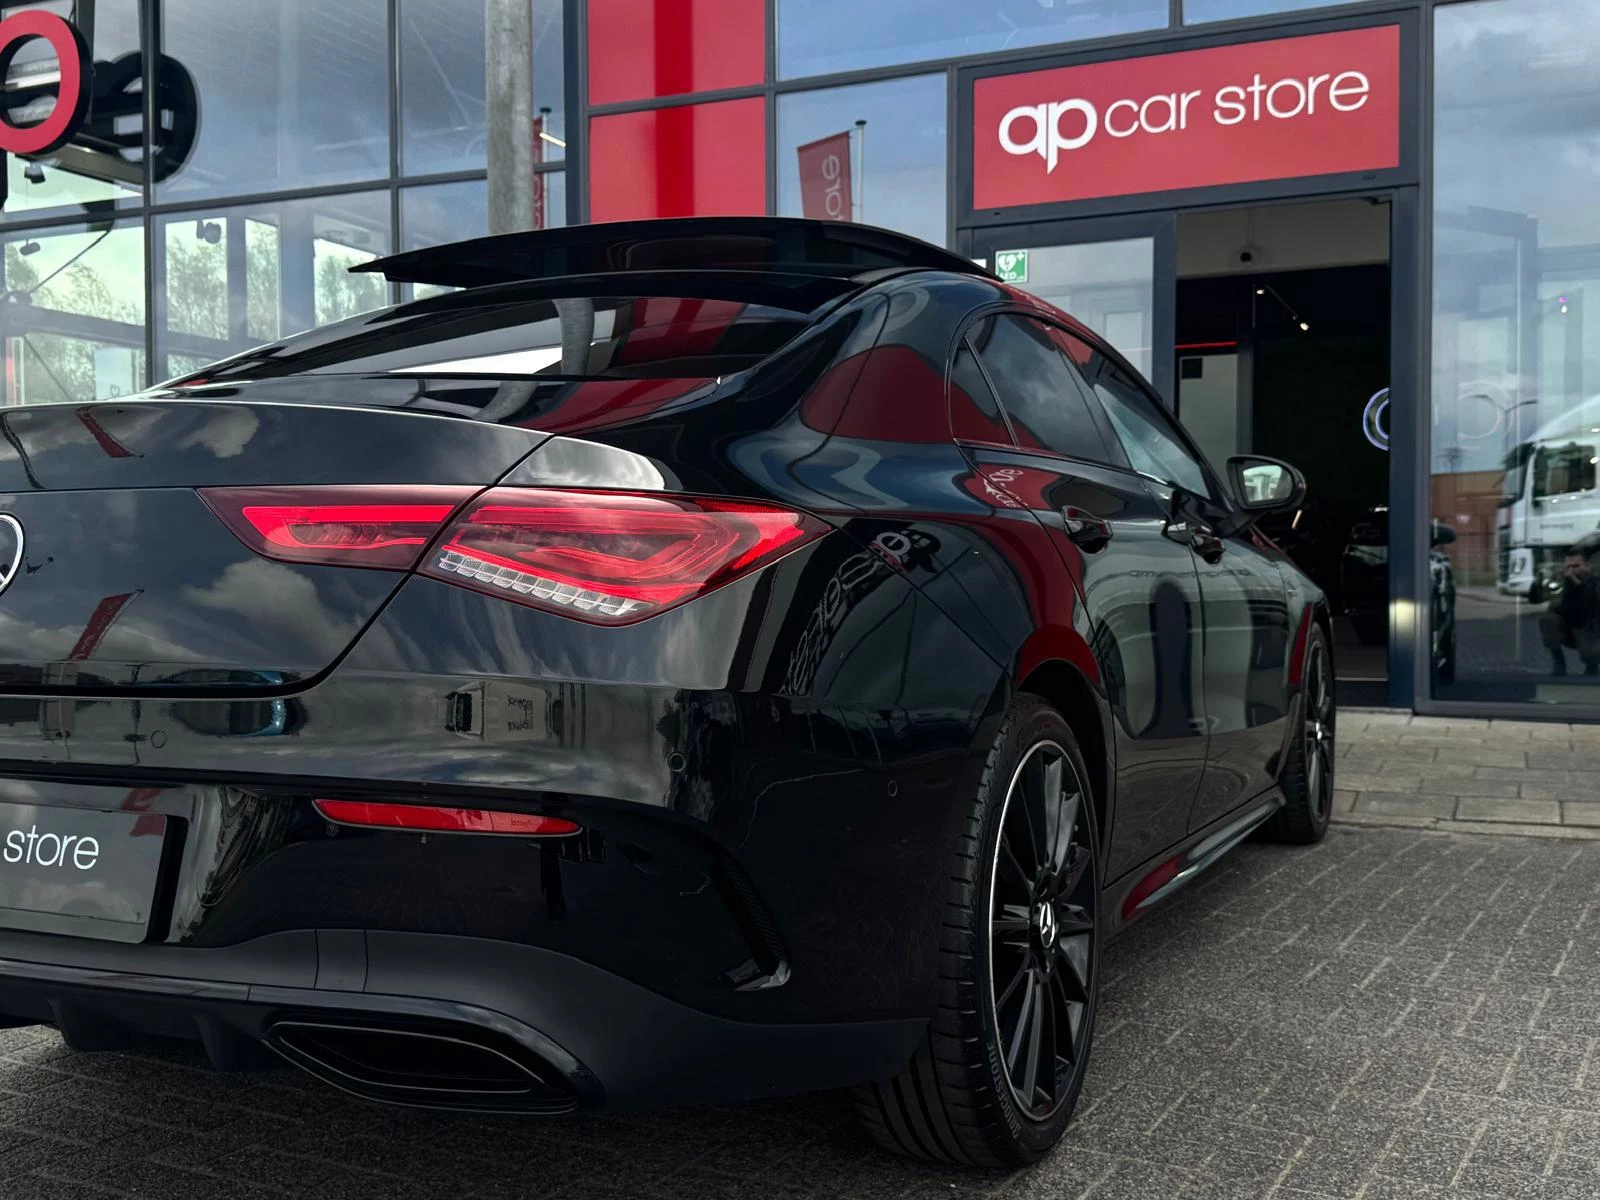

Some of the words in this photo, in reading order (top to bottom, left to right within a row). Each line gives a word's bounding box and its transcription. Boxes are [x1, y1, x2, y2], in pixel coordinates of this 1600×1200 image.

[998, 97, 1098, 175] ap
[1104, 89, 1200, 138] car
[1213, 70, 1370, 126] store
[3, 825, 99, 870] store
